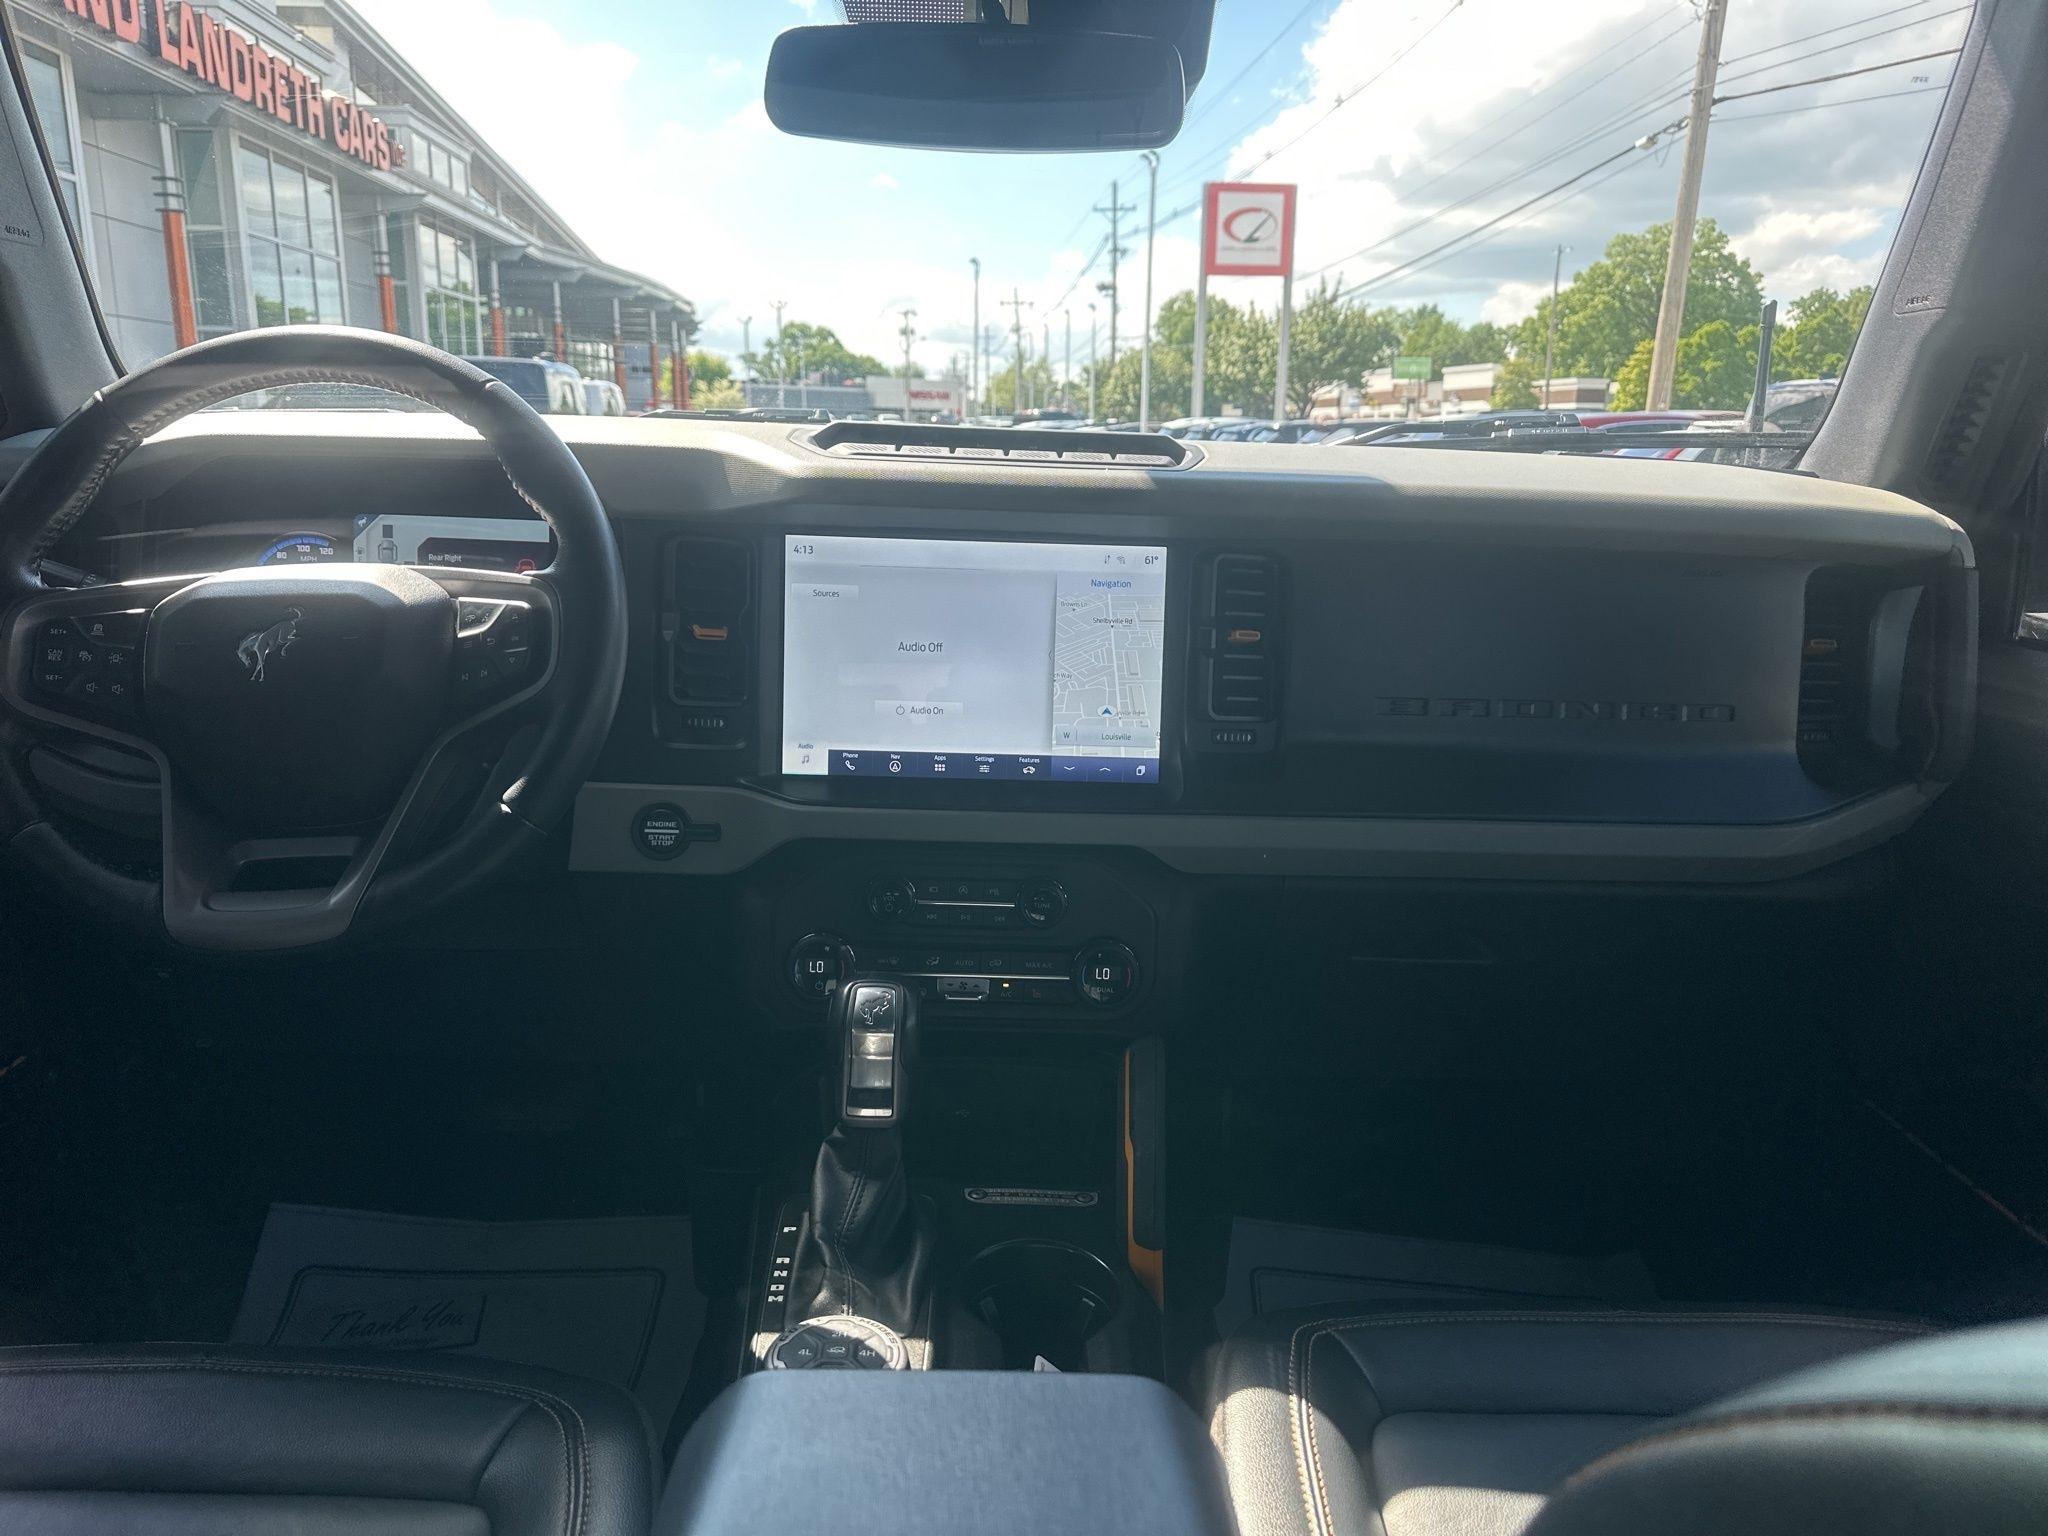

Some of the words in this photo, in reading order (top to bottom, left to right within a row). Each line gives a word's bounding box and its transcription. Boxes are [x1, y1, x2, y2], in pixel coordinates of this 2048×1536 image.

[156, 0, 325, 140] LANDRETH
[332, 97, 391, 171] CARS
[296, 544, 310, 552] 100
[319, 547, 333, 555] 120
[793, 544, 815, 555] 4:13
[428, 553, 443, 561] Rear
[444, 554, 462, 563] Right
[1144, 555, 1160, 565] 61°
[1090, 579, 1132, 590] Navigation
[812, 589, 840, 598] Sources
[1092, 617, 1124, 625] Shelbyville
[898, 641, 926, 652] Audio
[928, 642, 944, 652] Off
[910, 705, 932, 715] Audio
[932, 706, 944, 715] On
[1375, 697, 1735, 723] BRONCO
[1063, 731, 1071, 739] W
[1101, 733, 1132, 741] Louisville
[934, 754, 947, 762] Apps
[974, 754, 995, 763] Settings
[646, 820, 677, 828] ENGINE
[809, 960, 824, 974] LO
[1094, 967, 1110, 980] LO
[321, 1305, 418, 1341] Thank
[421, 1300, 464, 1331] You
[860, 1319, 898, 1344] MODES
[798, 1348, 812, 1356] 4L
[858, 1349, 876, 1357] 4H
